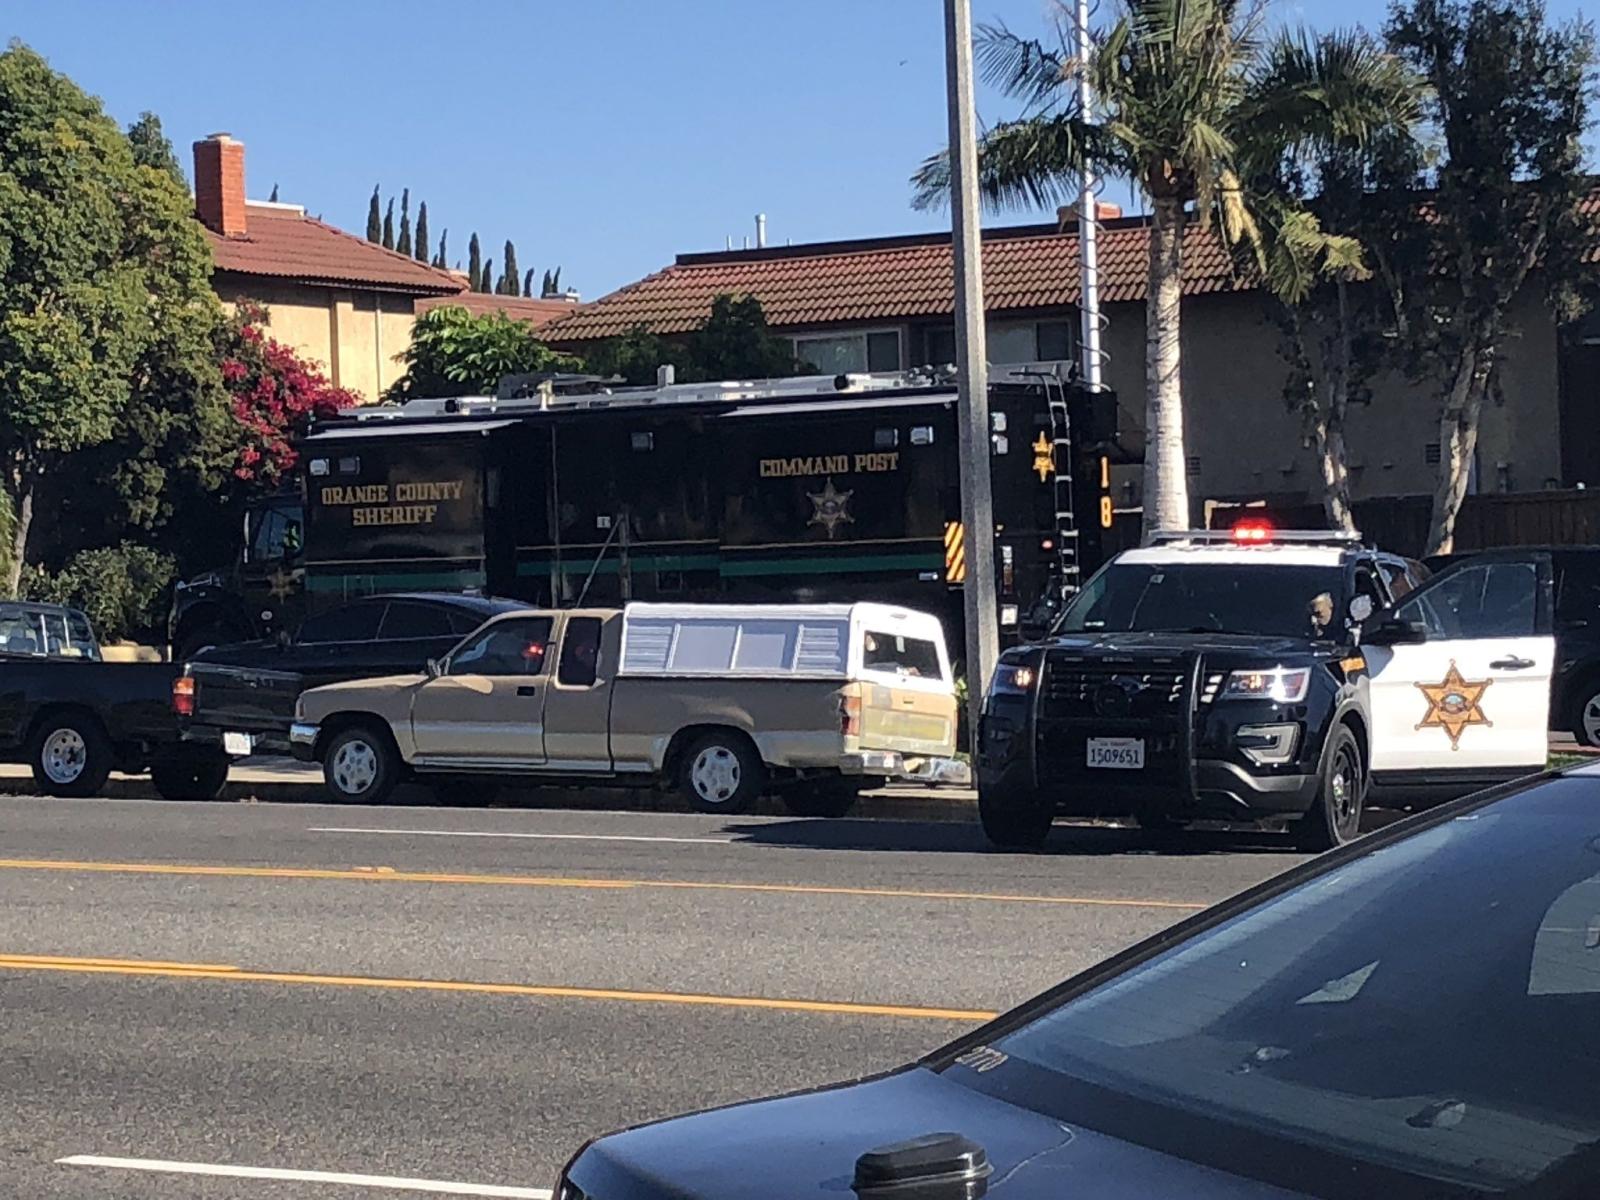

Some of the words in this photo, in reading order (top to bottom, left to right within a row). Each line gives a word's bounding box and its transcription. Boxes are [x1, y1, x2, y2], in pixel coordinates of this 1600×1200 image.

[759, 454, 849, 478] COMMAND
[854, 452, 899, 473] POST
[321, 484, 389, 505] ORANGE
[395, 480, 464, 501] COUNTY
[352, 504, 438, 526] SHERIFF
[1090, 748, 1140, 765] 1509651
